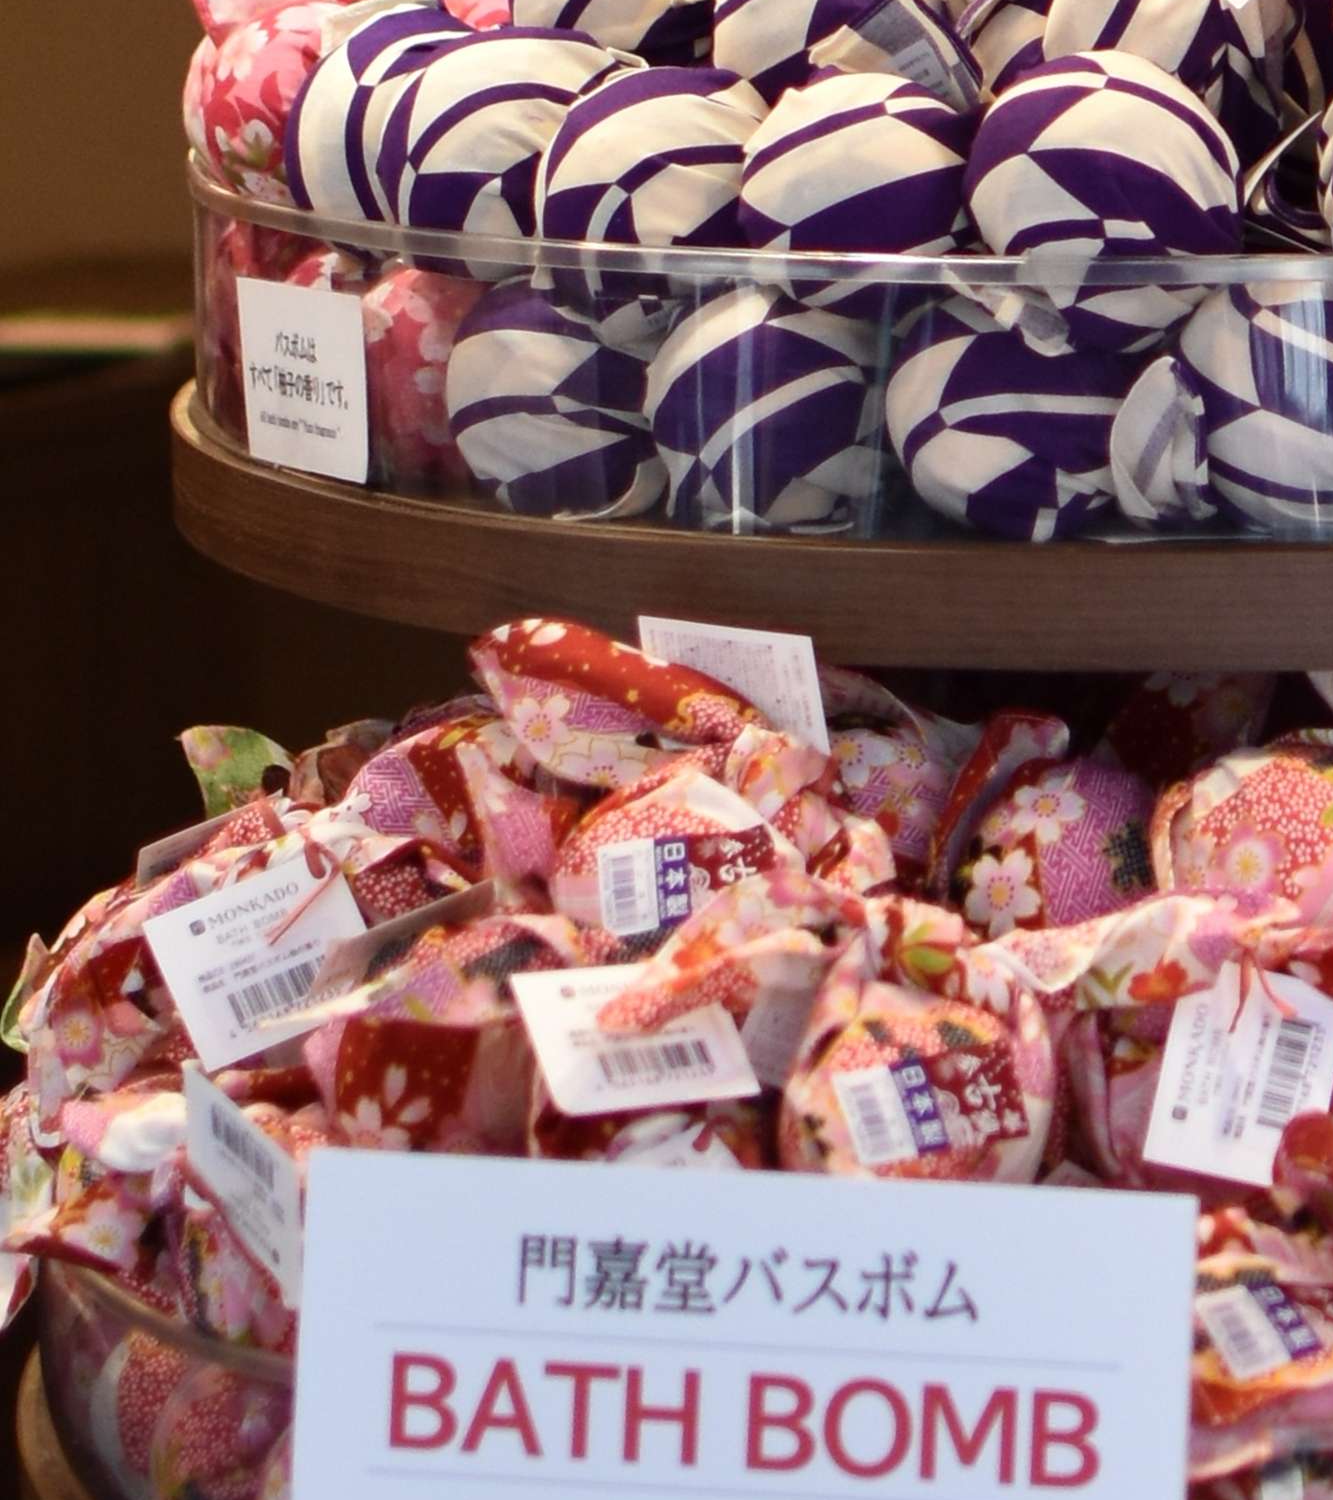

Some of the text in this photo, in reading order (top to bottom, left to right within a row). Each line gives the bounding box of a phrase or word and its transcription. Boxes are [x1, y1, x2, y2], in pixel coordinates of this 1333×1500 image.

[274, 331, 318, 363] バスボムは
[206, 880, 301, 929] MONKADO
[662, 841, 689, 917] 日本製
[1177, 1001, 1208, 1101] MONKADO
[901, 1065, 944, 1147] 日本製
[516, 1232, 982, 1323] 門嘉堂バスボム
[388, 1350, 1101, 1491] BATH BOMB
